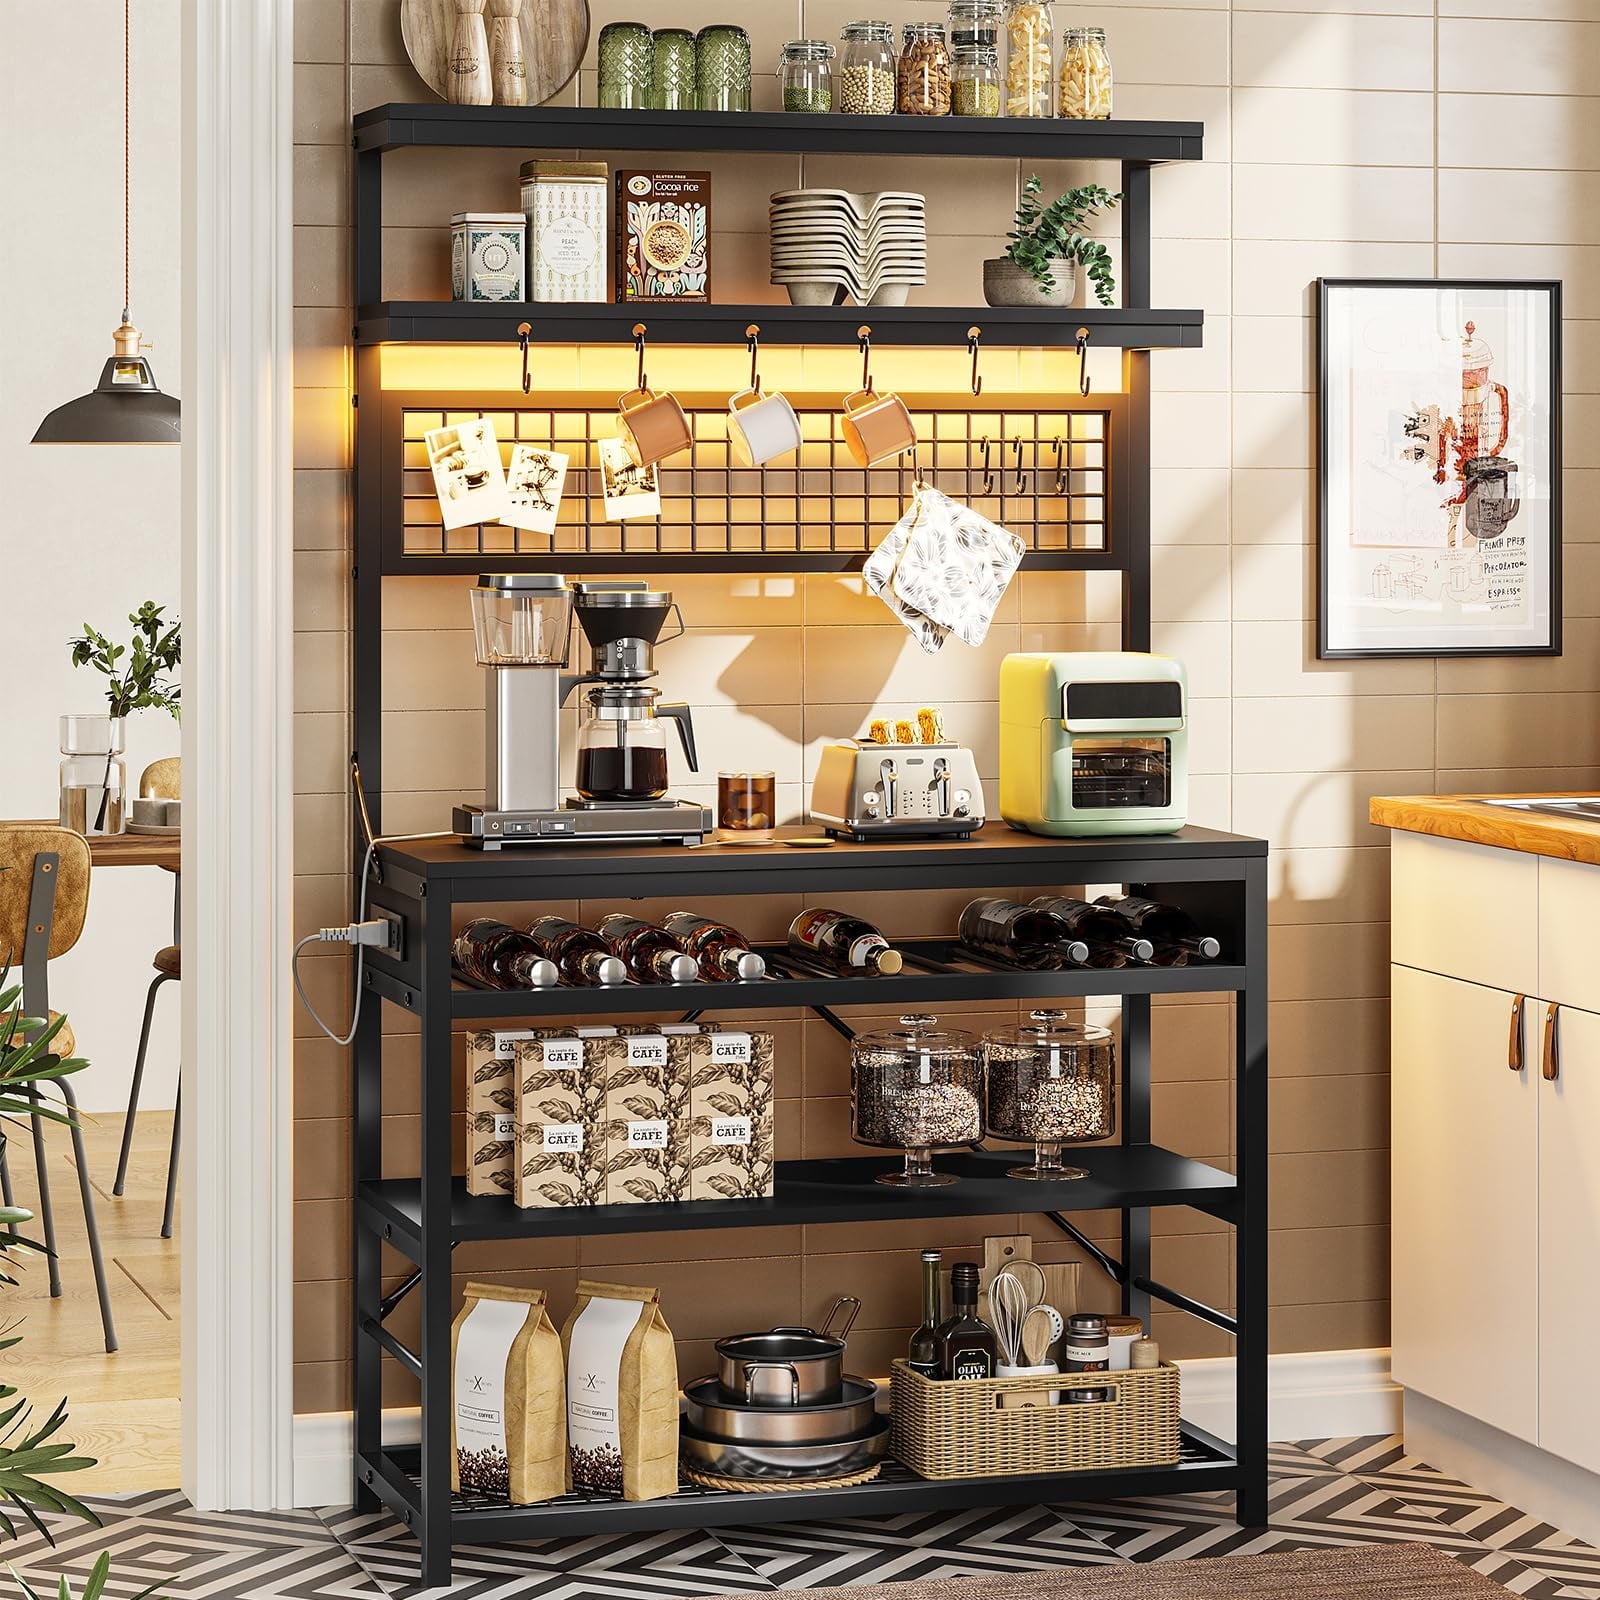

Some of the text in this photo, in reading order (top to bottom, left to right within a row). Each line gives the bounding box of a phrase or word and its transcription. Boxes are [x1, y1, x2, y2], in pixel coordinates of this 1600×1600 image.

[654, 182, 681, 191] Cocoa
[683, 182, 699, 192] rice
[633, 1049, 662, 1058] CAFE
[716, 1046, 746, 1055] CAFE
[548, 1053, 578, 1061] CAFE
[500, 1125, 514, 1133] CA
[716, 1128, 746, 1137] CAFE
[548, 1135, 578, 1144] CAFE
[633, 1131, 662, 1140] CAFE
[958, 1365, 986, 1374] OLIVE
